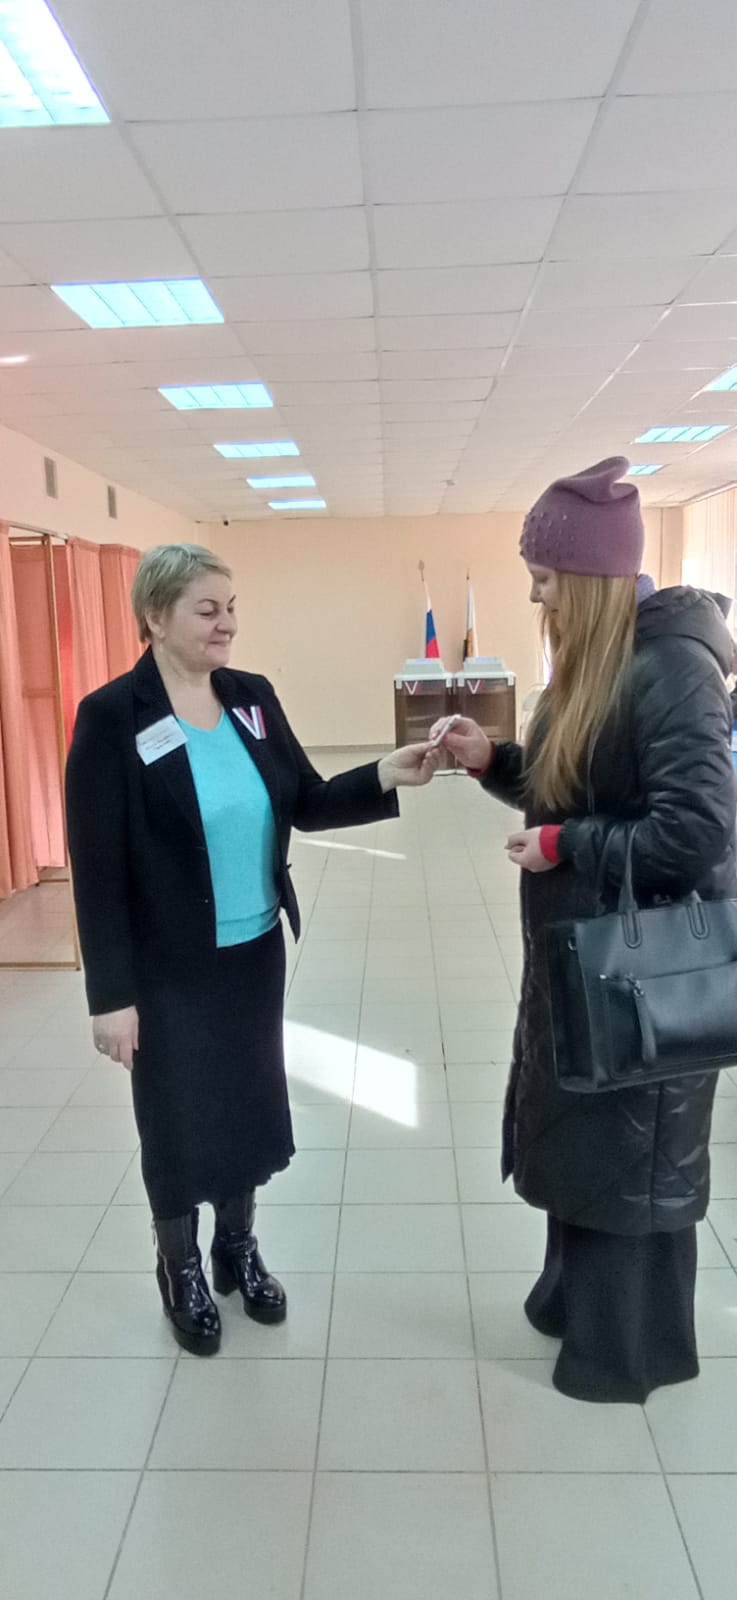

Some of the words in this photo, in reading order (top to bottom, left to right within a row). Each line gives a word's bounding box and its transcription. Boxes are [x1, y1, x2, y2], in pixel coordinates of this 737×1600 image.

[404, 681, 421, 695] V
[467, 680, 484, 694] V
[232, 705, 266, 740] V
